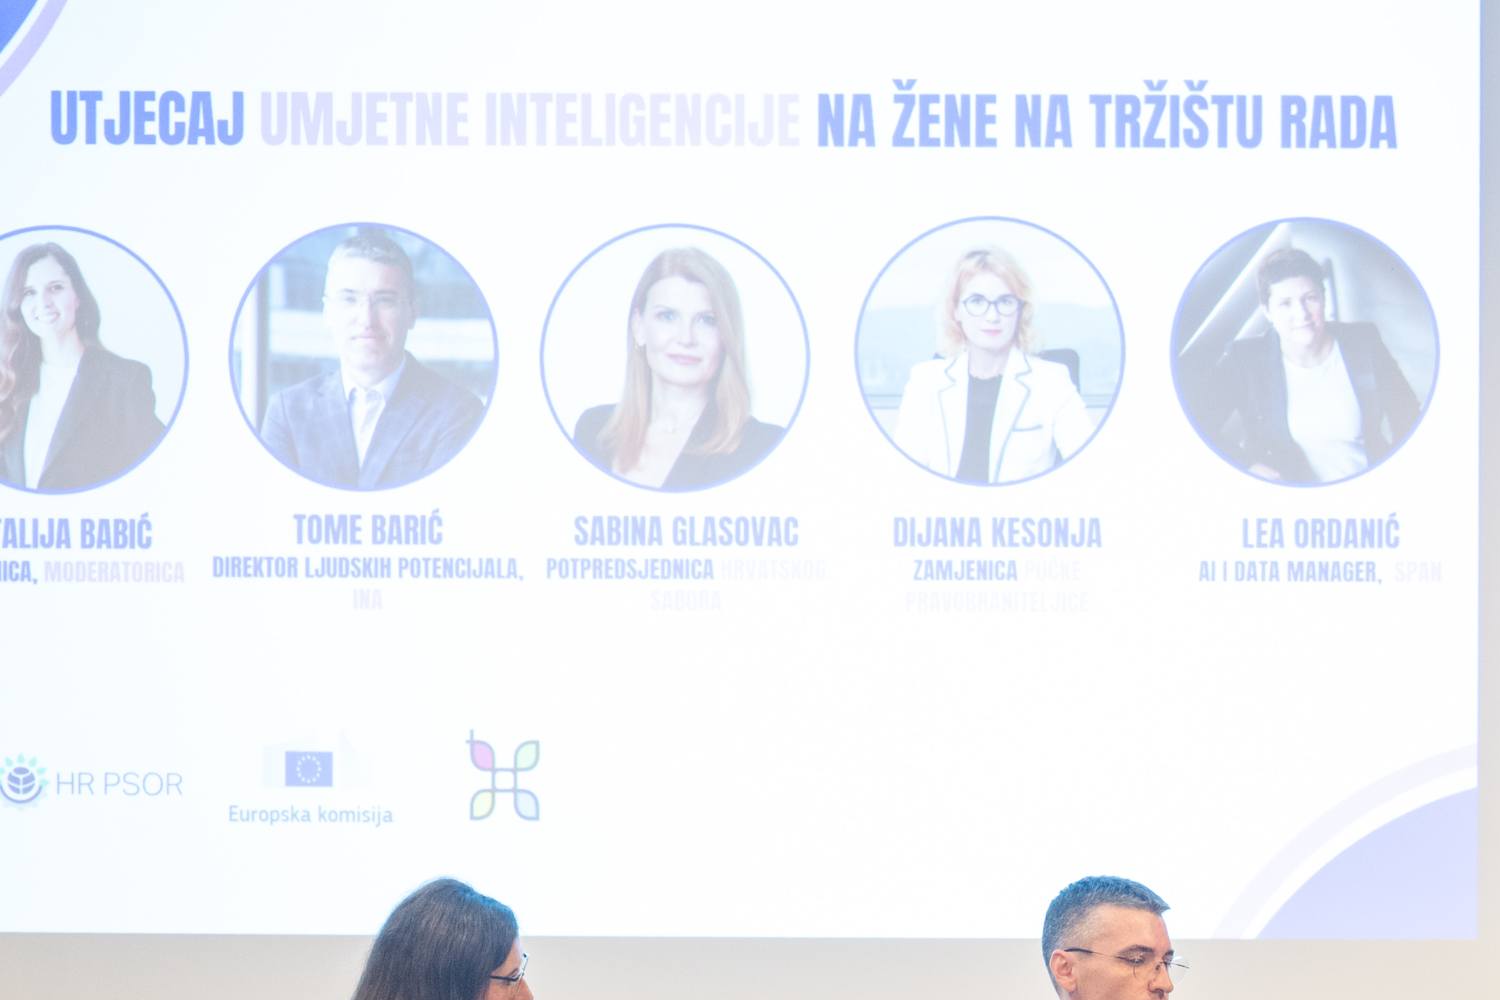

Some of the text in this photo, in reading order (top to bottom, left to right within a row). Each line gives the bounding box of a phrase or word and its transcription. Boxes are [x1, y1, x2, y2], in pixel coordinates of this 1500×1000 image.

[51, 79, 1397, 149] UTJECAJ UMJETNE INTELIGENCIJE NA ŽENE NA TRŽIŠTU RADA
[0, 512, 152, 549] ALIJA BABIĆ
[293, 508, 443, 545] TOME BARIĆ
[574, 516, 798, 546] SABINA GLASOVAC
[894, 517, 1102, 548] DIJANA KESONJA
[1243, 512, 1400, 548] LEA ORDANIĆ
[0, 560, 184, 584] ICA, MODERATORICA
[213, 556, 523, 580] DIREKTOR LJUDSKIH POTENCIJALA,
[547, 558, 714, 580] POTPREDSJEDNICA
[913, 560, 1017, 581] ZAMJENICA
[1199, 560, 1442, 584] AI I DATA MANAGER, SPAN
[353, 588, 382, 609] INA
[56, 772, 183, 796] HR PSOR
[229, 805, 393, 827] Europska komisija
